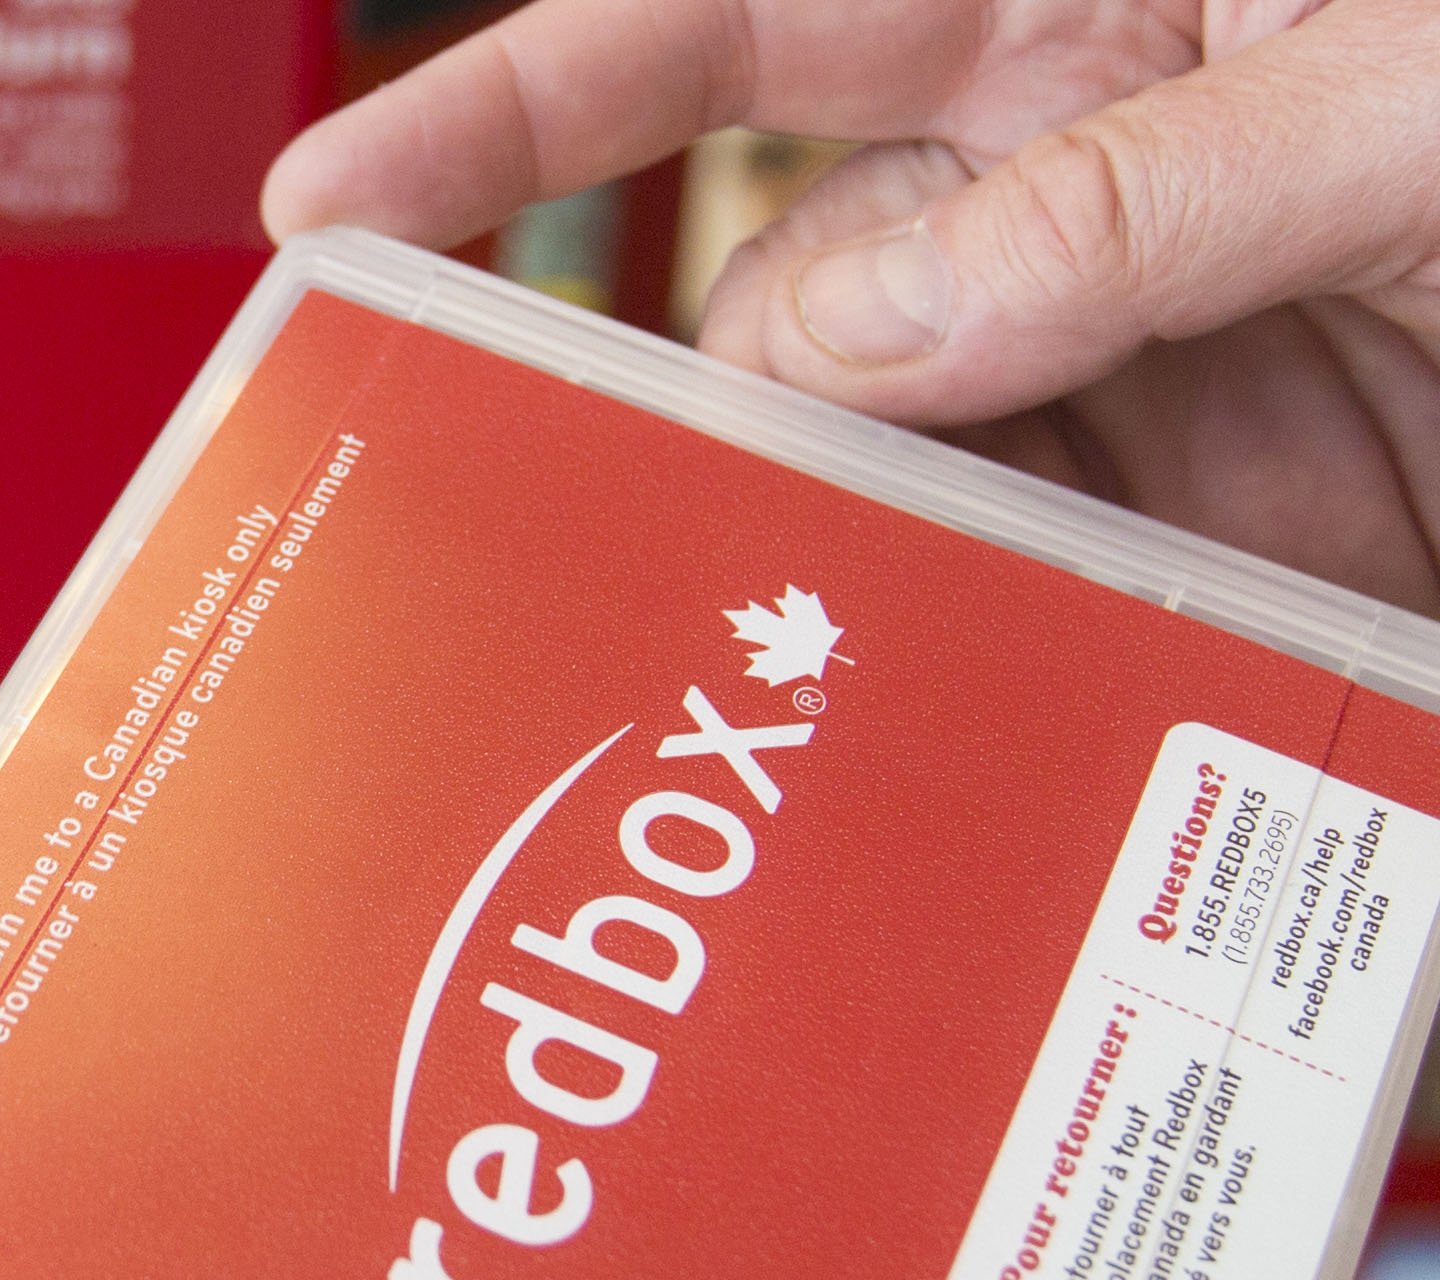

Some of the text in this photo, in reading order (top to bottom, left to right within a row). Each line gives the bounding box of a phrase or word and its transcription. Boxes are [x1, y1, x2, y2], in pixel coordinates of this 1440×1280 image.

[227, 505, 278, 561] only
[169, 568, 236, 640] kiosk
[65, 881, 97, 901] à
[88, 832, 126, 871] un
[108, 711, 199, 824] kiosque
[191, 578, 280, 703] canadien
[271, 434, 365, 572] seulement
[84, 648, 187, 781] Canadian
[44, 818, 81, 848] to
[75, 791, 99, 809] a
[15, 857, 58, 905] me
[1139, 763, 1227, 943] Questions?
[1186, 788, 1266, 957] 1.855.REDBOX5
[1222, 810, 1298, 964] (1.855.733.2695)
[1272, 829, 1344, 988] redbox.ca/help
[1289, 808, 1388, 1039] facebook.com/redbox
[1351, 895, 1389, 971] canada
[1112, 1106, 1149, 1157] tout
[1152, 1060, 1207, 1151] Redbox
[1180, 1173, 1204, 1203] en
[1194, 1068, 1241, 1167] gardant
[1103, 1166, 1128, 1181] à
[1199, 1213, 1231, 1262] vers
[1219, 1143, 1257, 1206] vous.
